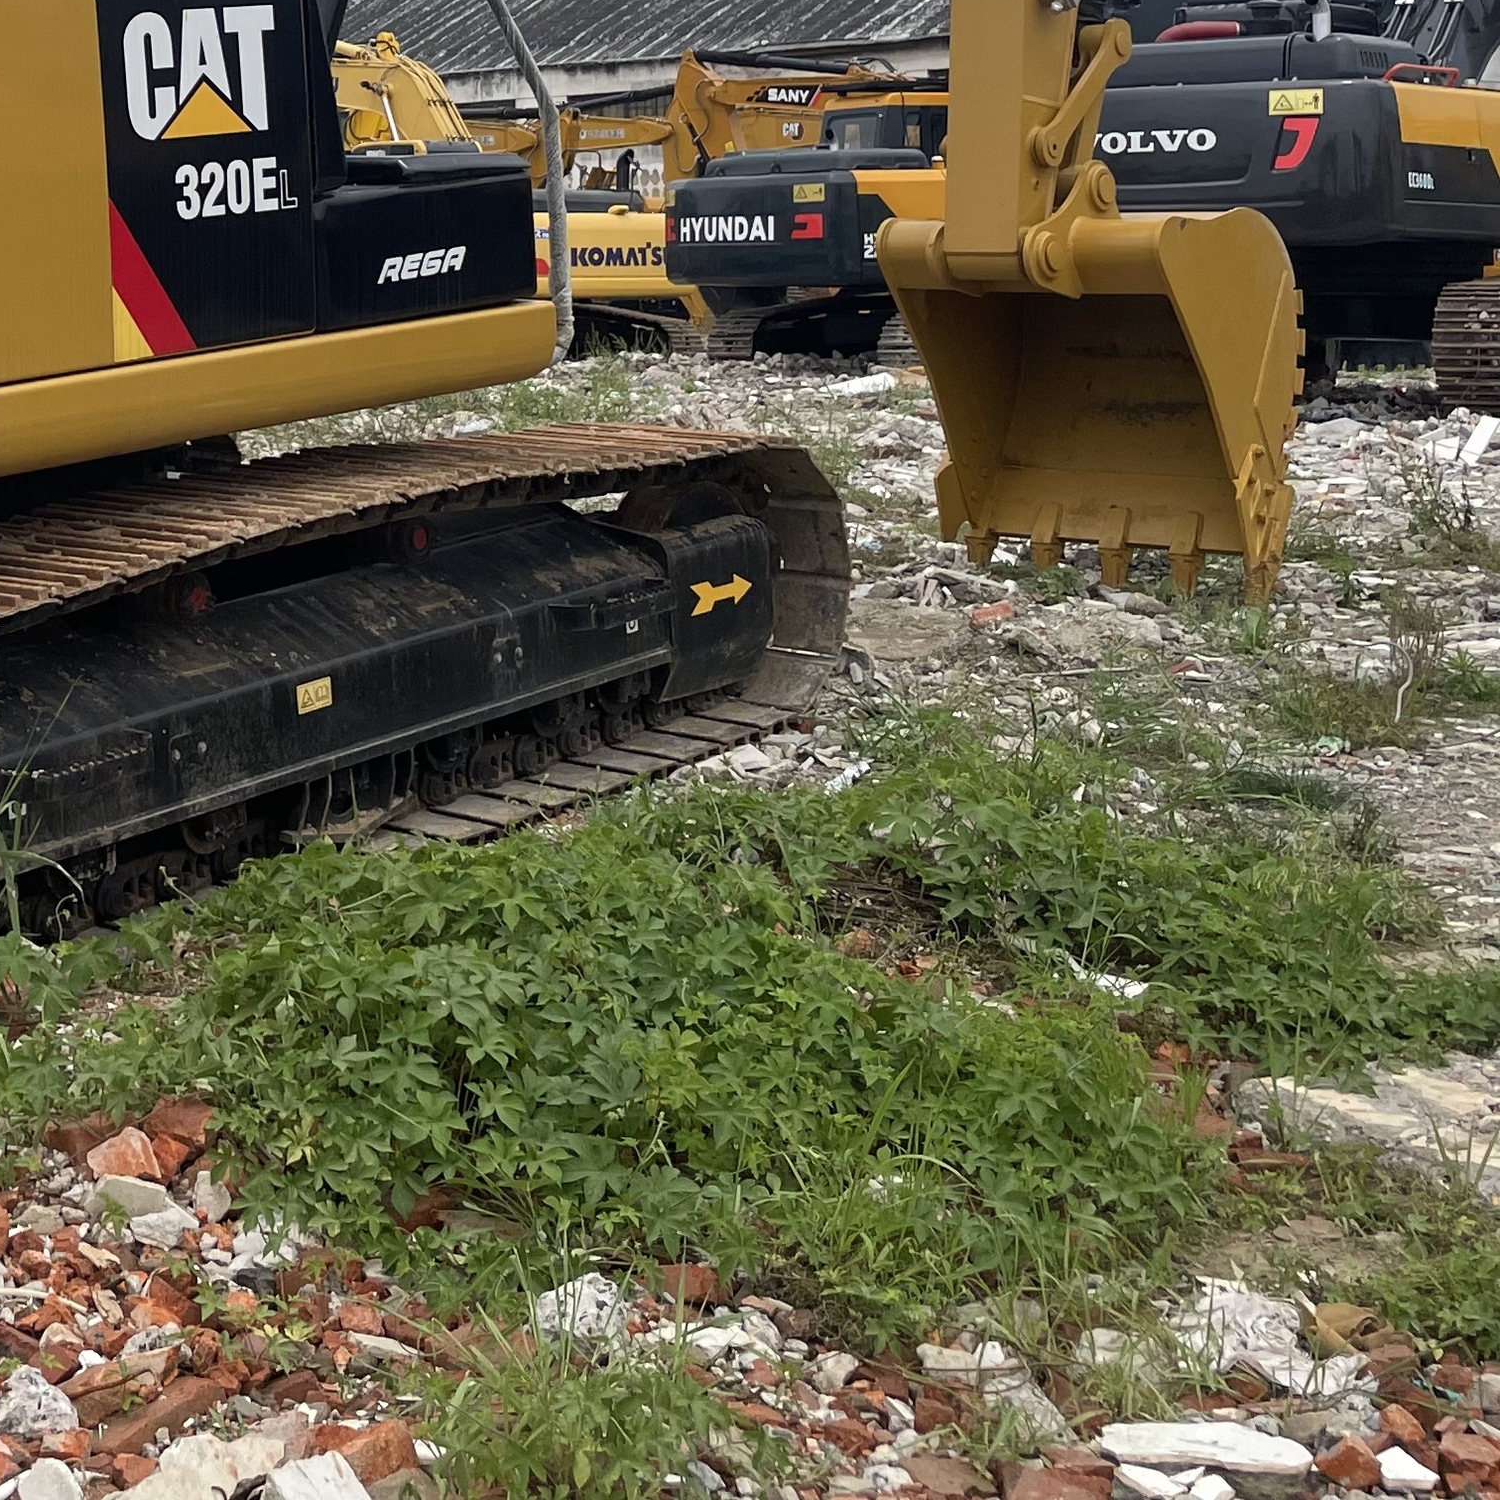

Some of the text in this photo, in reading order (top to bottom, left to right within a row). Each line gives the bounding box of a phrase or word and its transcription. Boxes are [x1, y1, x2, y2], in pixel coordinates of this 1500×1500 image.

[123, 4, 275, 141] CAT
[767, 88, 810, 104] SANY
[782, 122, 800, 137] CAT
[680, 215, 775, 243] HYUNDAI
[377, 245, 466, 285] REGA
[570, 242, 666, 267] KOMATS
